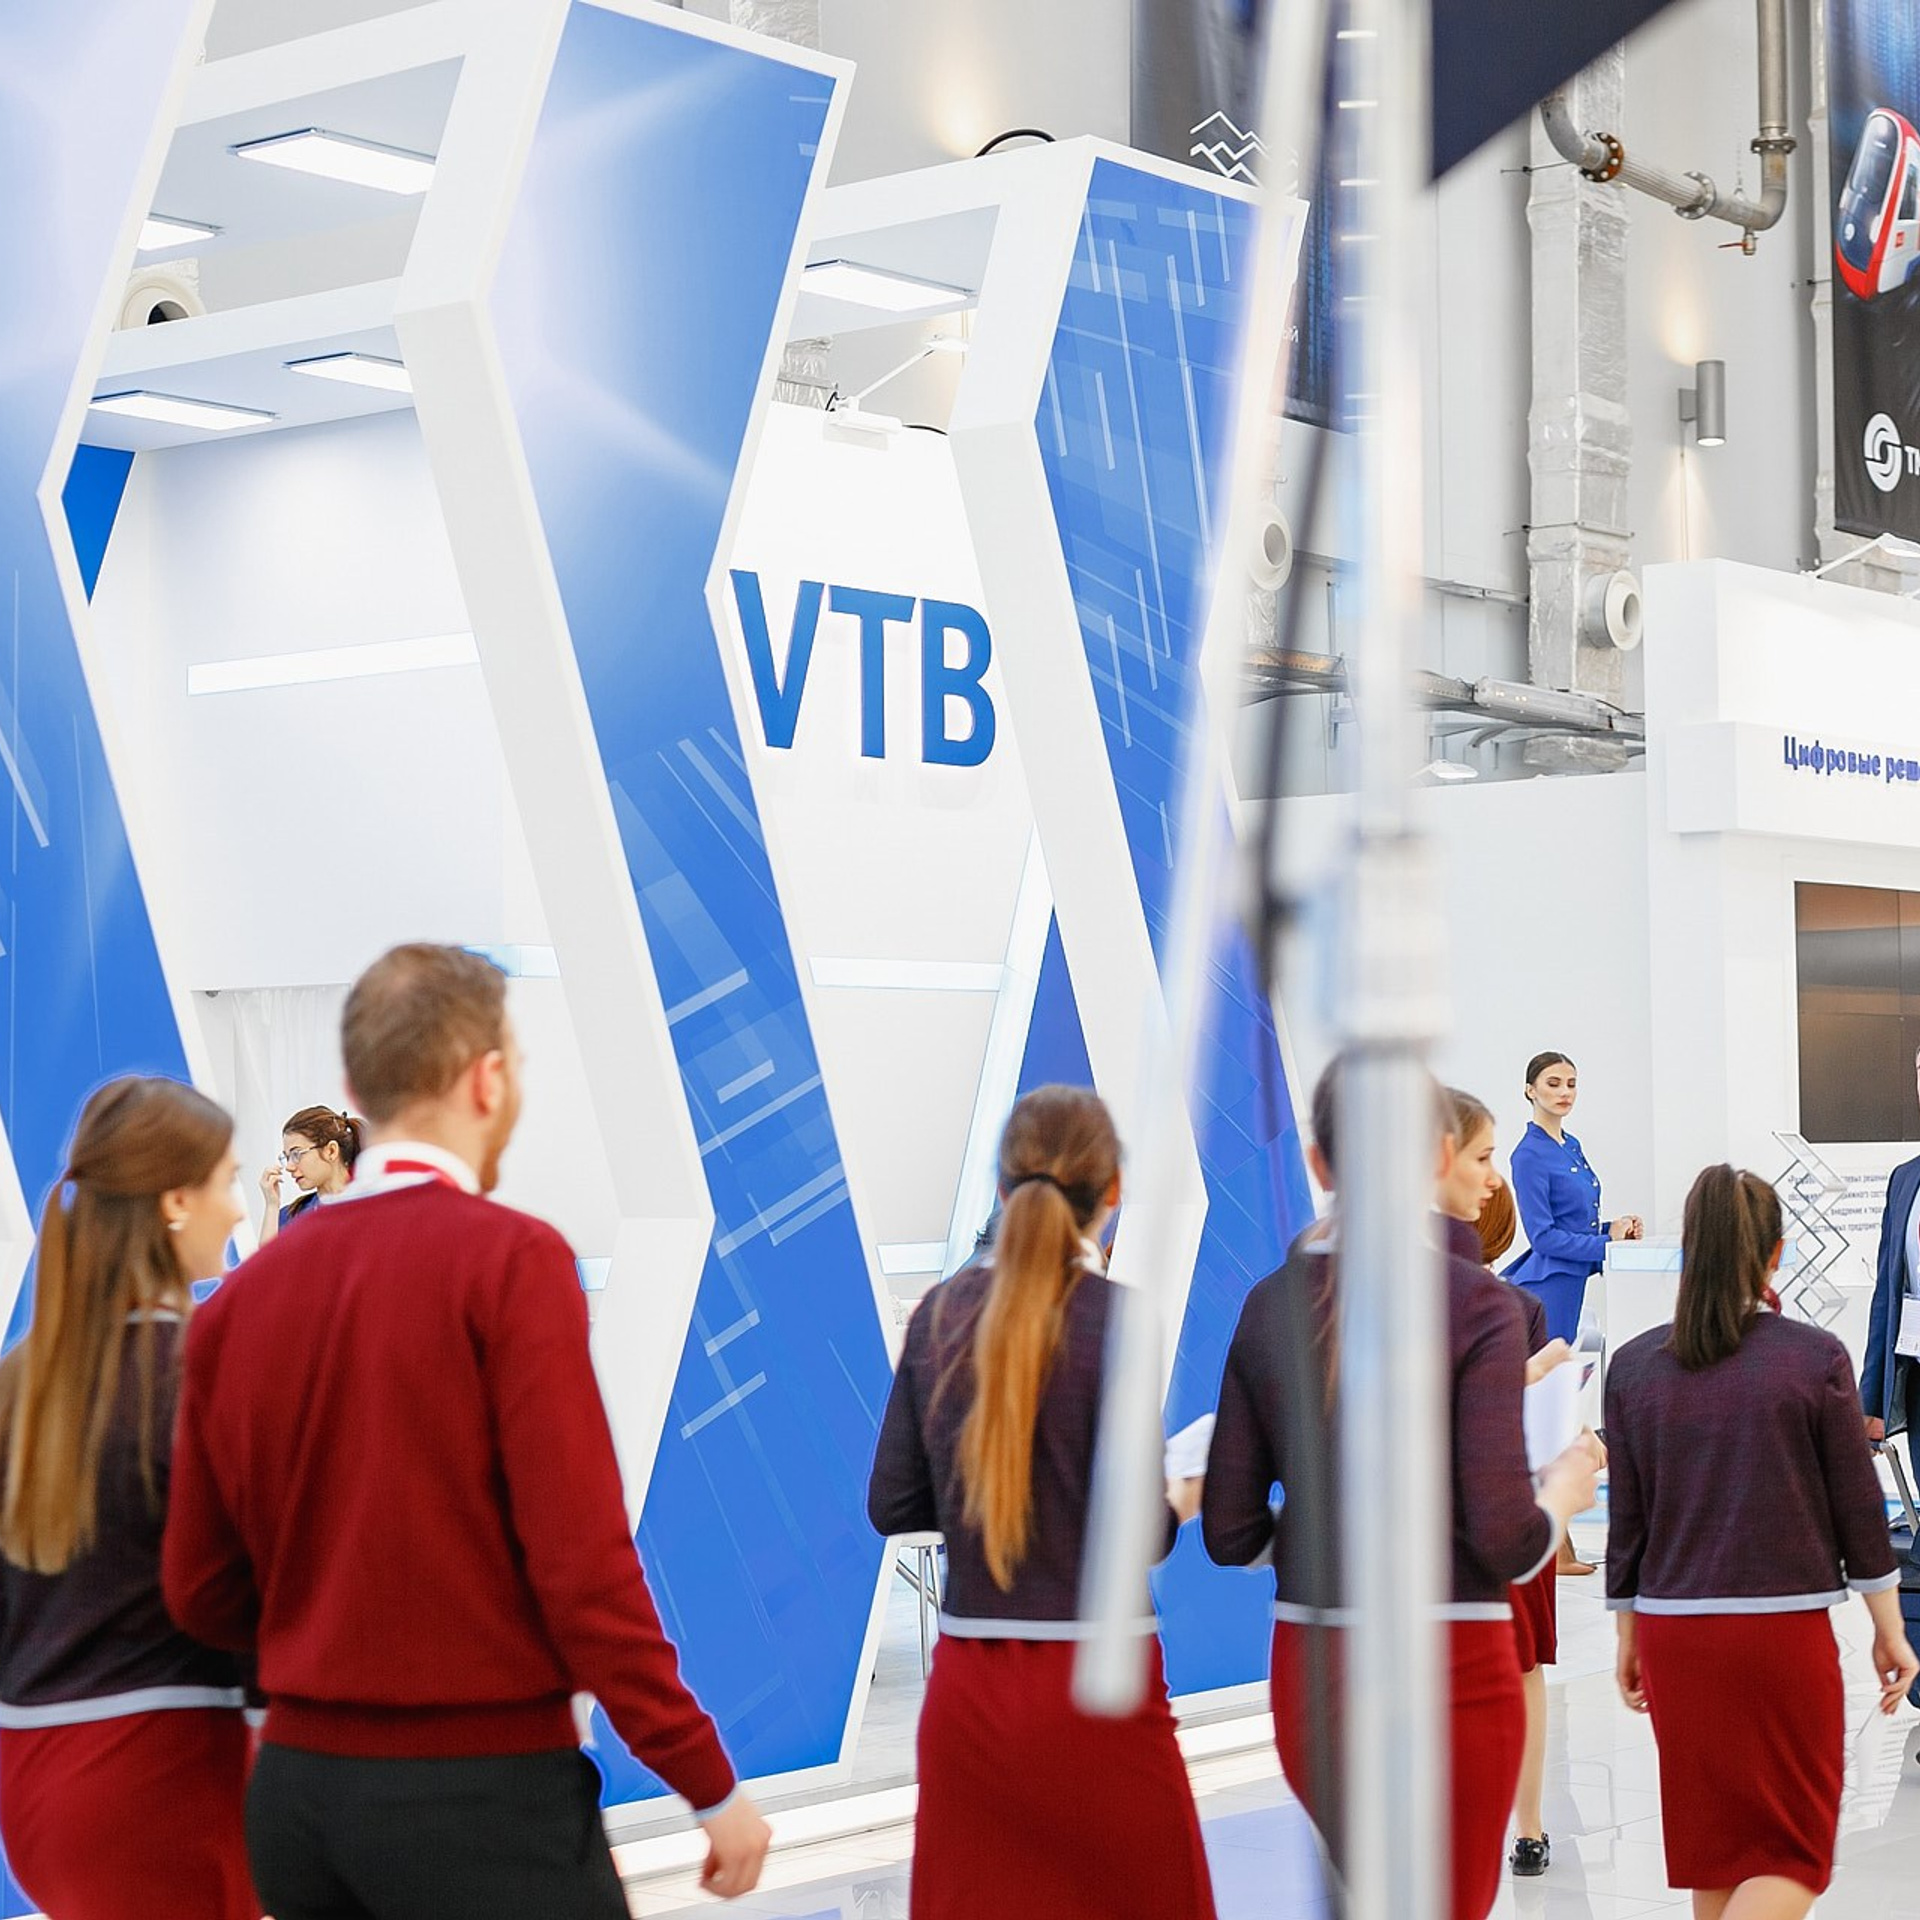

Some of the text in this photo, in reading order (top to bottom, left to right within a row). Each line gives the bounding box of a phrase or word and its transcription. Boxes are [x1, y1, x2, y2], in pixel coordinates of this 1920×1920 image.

[729, 568, 996, 767] VTB
[1784, 735, 1920, 783] Цифровые реш
